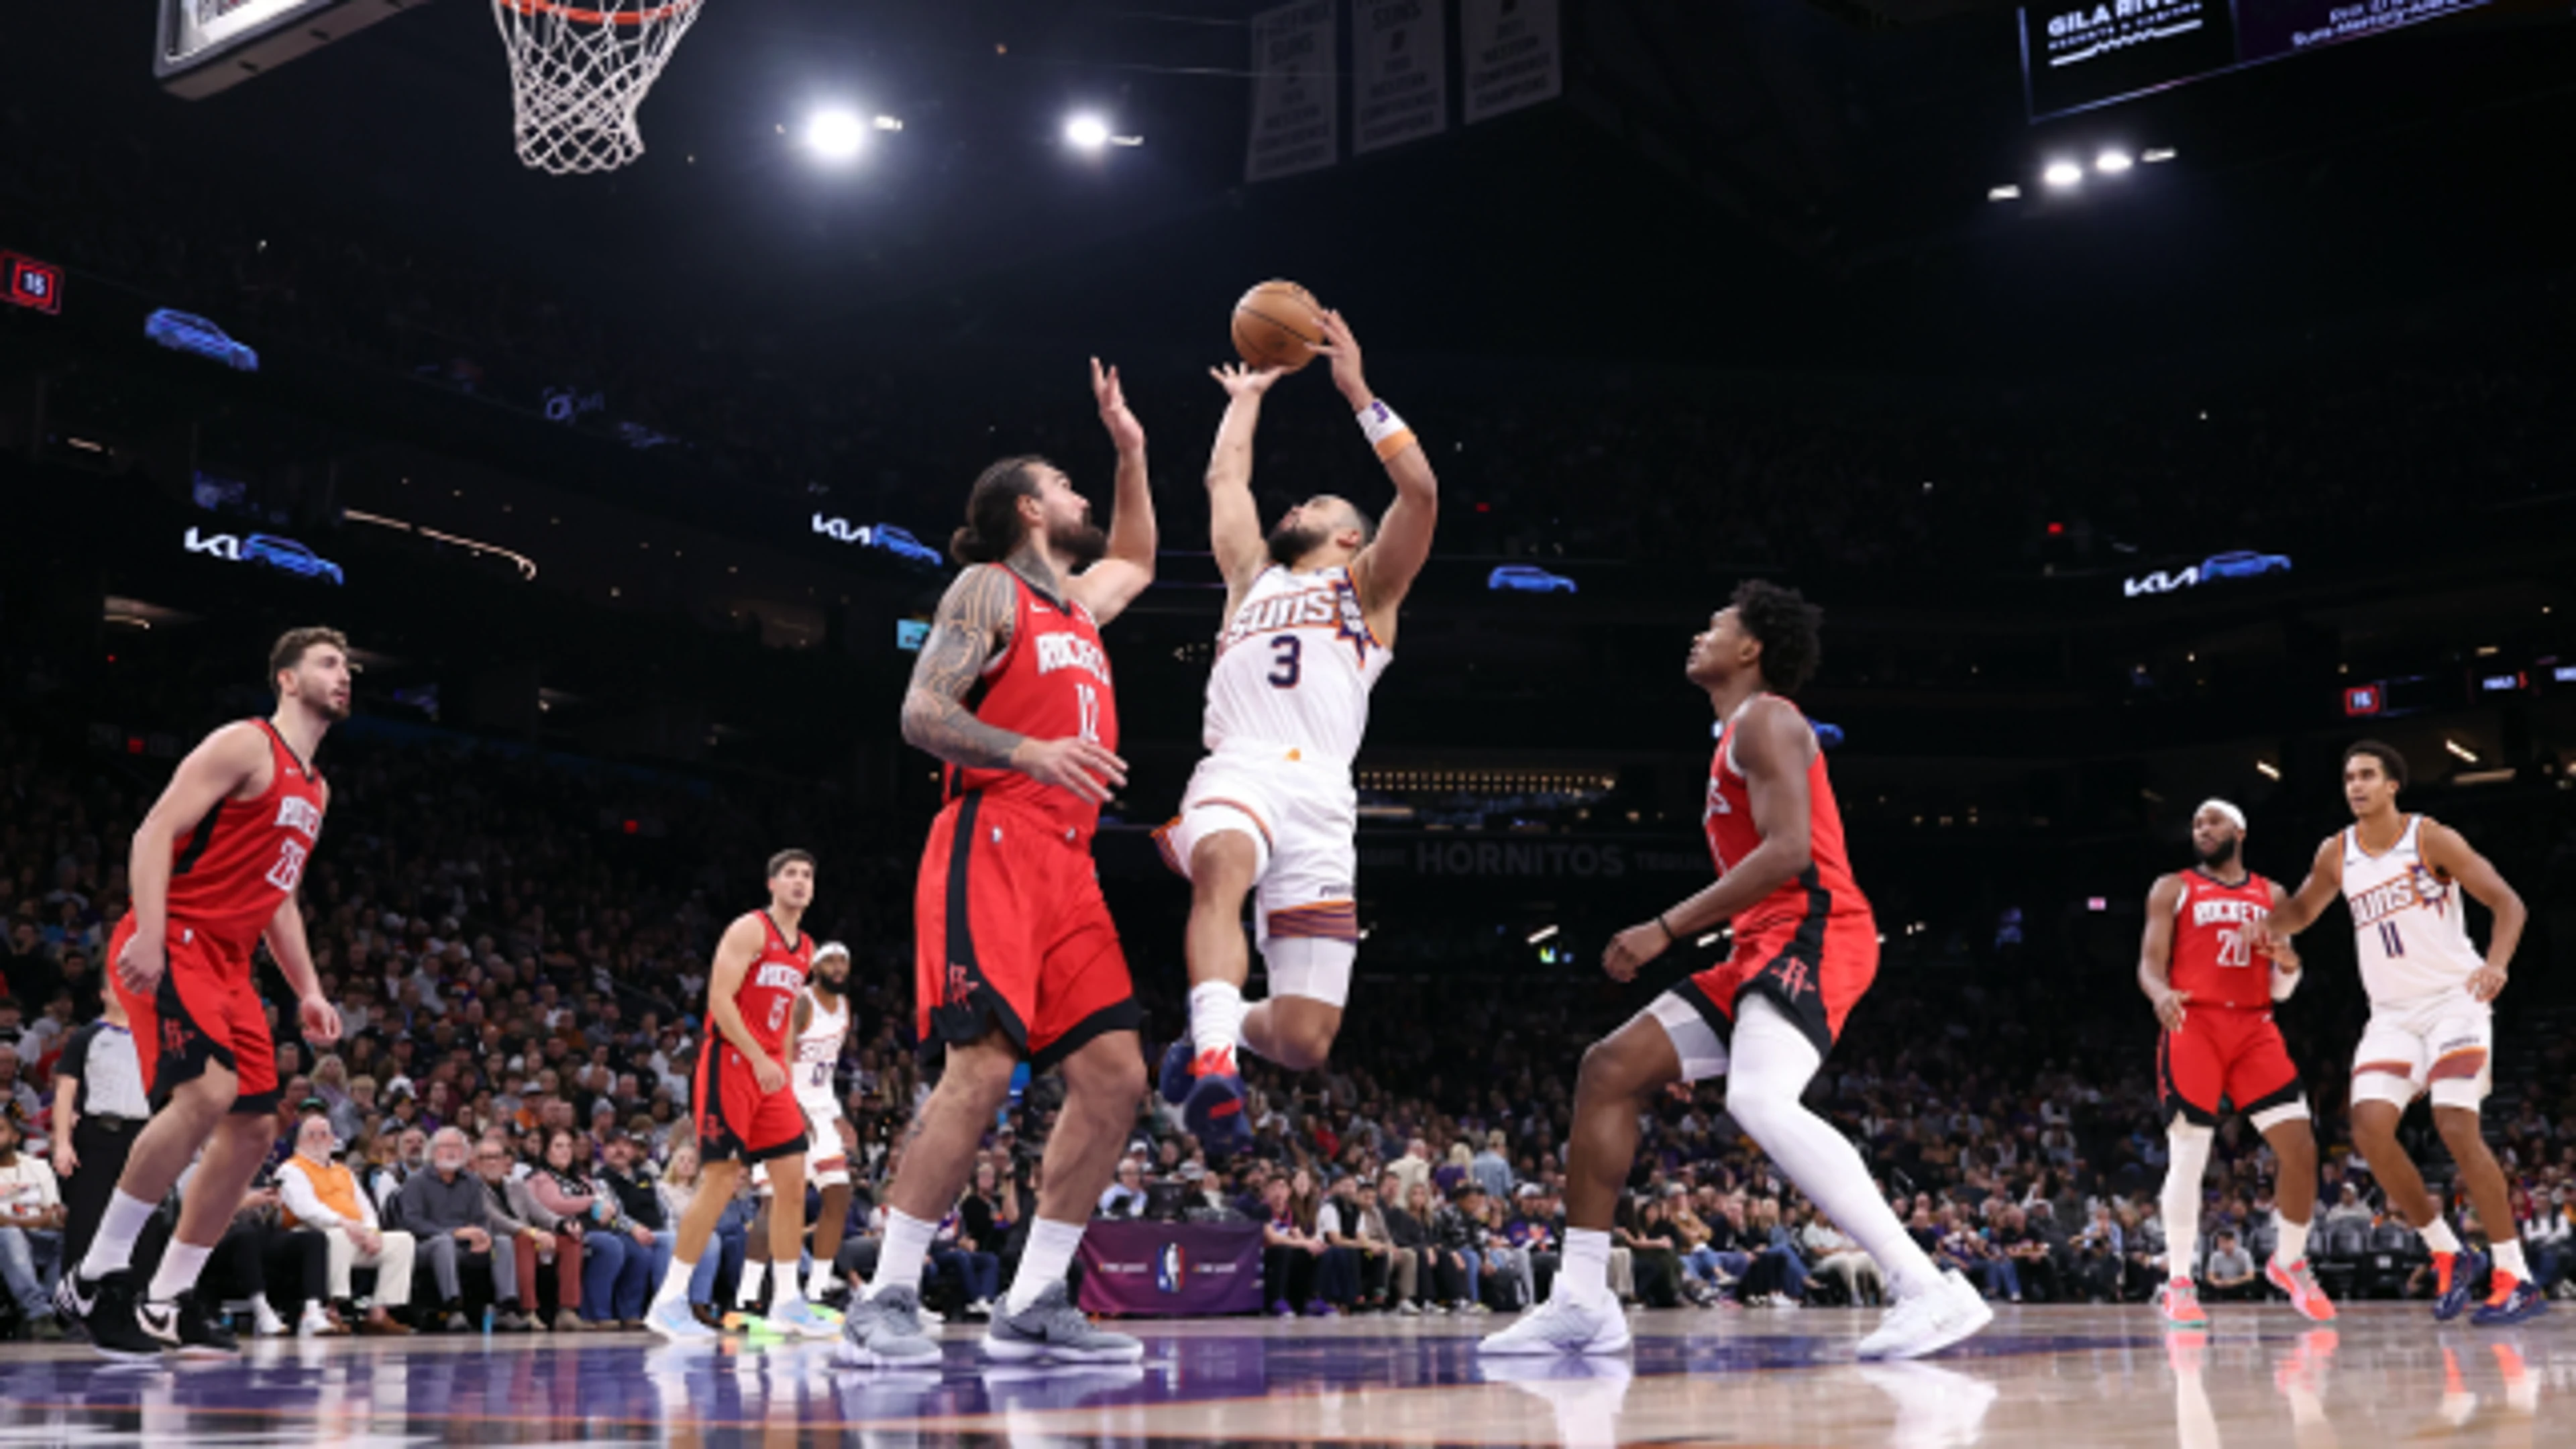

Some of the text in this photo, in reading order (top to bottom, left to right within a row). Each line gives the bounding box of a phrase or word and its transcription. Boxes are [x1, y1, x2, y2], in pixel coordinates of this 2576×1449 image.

[2048, 4, 2112, 37] GILA
[184, 527, 240, 559] KI
[1267, 634, 1301, 689] 3
[1075, 683, 1099, 744] 12
[268, 837, 307, 891] 28
[1415, 841, 1625, 877] HORNITOS
[2216, 928, 2251, 966] 20
[2378, 920, 2406, 959] 11
